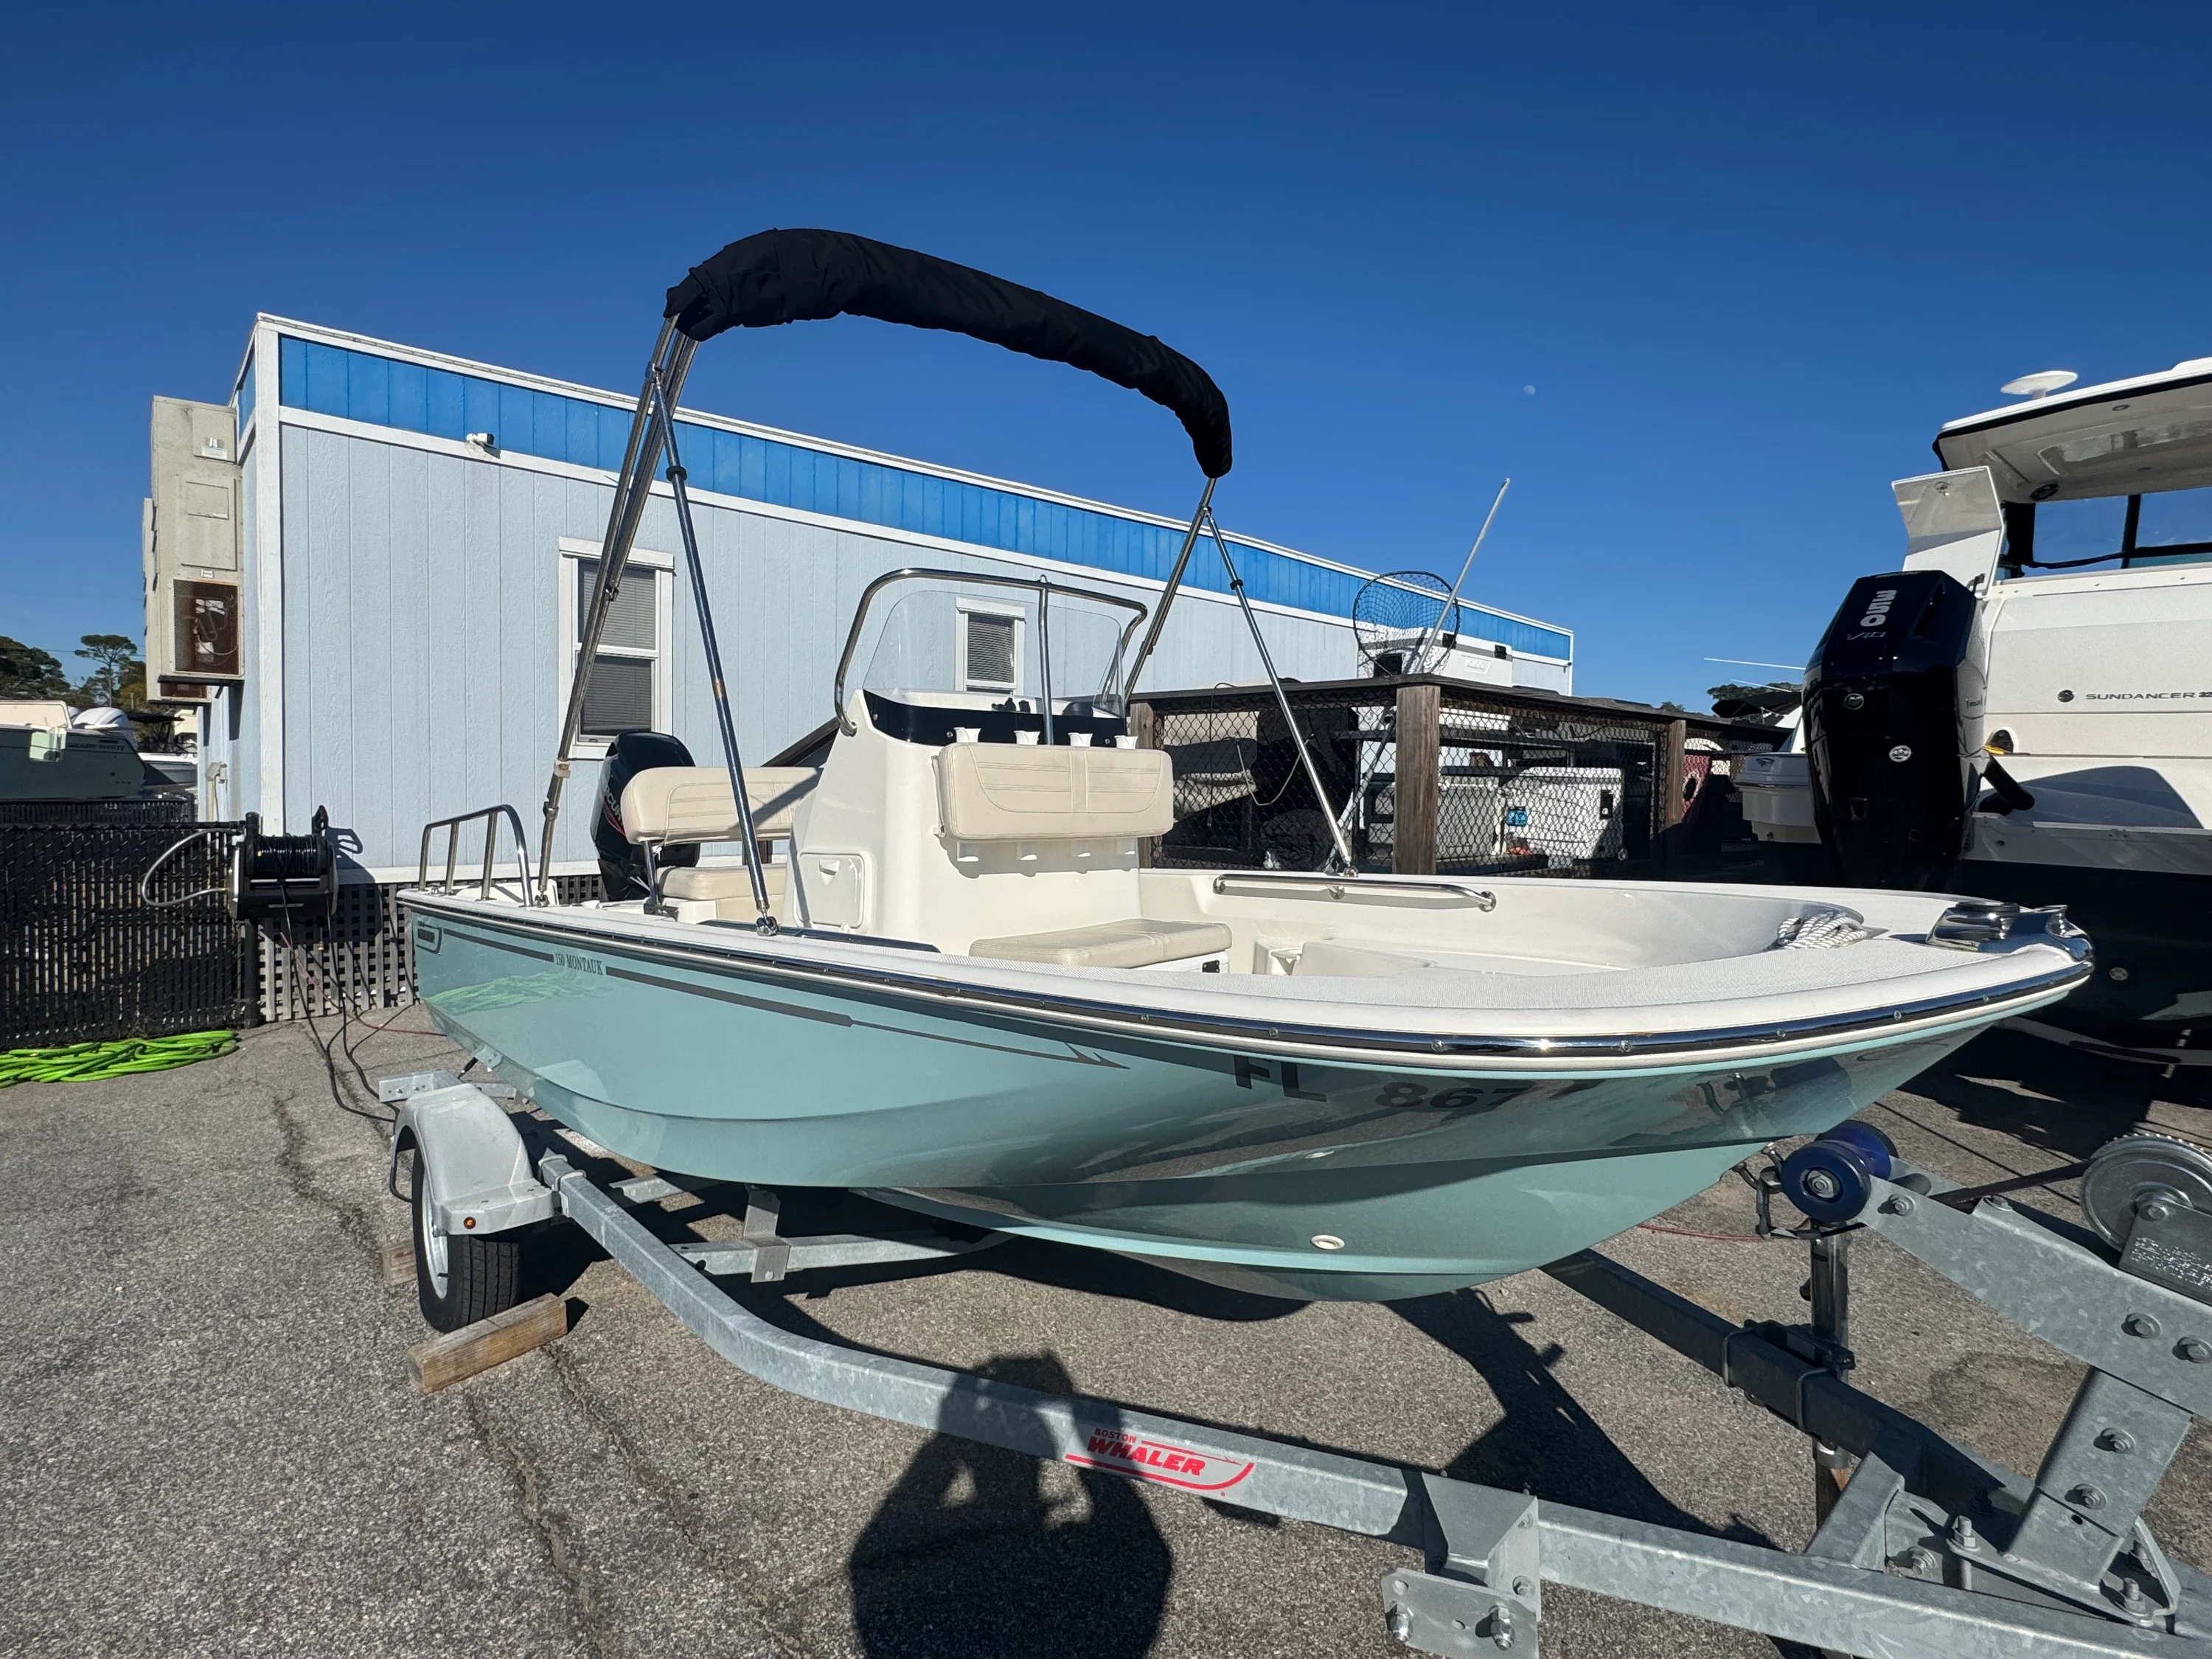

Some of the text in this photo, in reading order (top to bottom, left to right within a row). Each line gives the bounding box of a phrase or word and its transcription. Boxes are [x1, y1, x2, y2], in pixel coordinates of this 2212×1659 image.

[1860, 590, 1897, 627] 350
[2085, 692, 2195, 700] SUNDANCER
[554, 953, 603, 975] 150 MONTAUK
[1234, 1055, 1326, 1102] FL
[1095, 1427, 1137, 1443] BOSTON
[1087, 1436, 1206, 1476] WHALER
